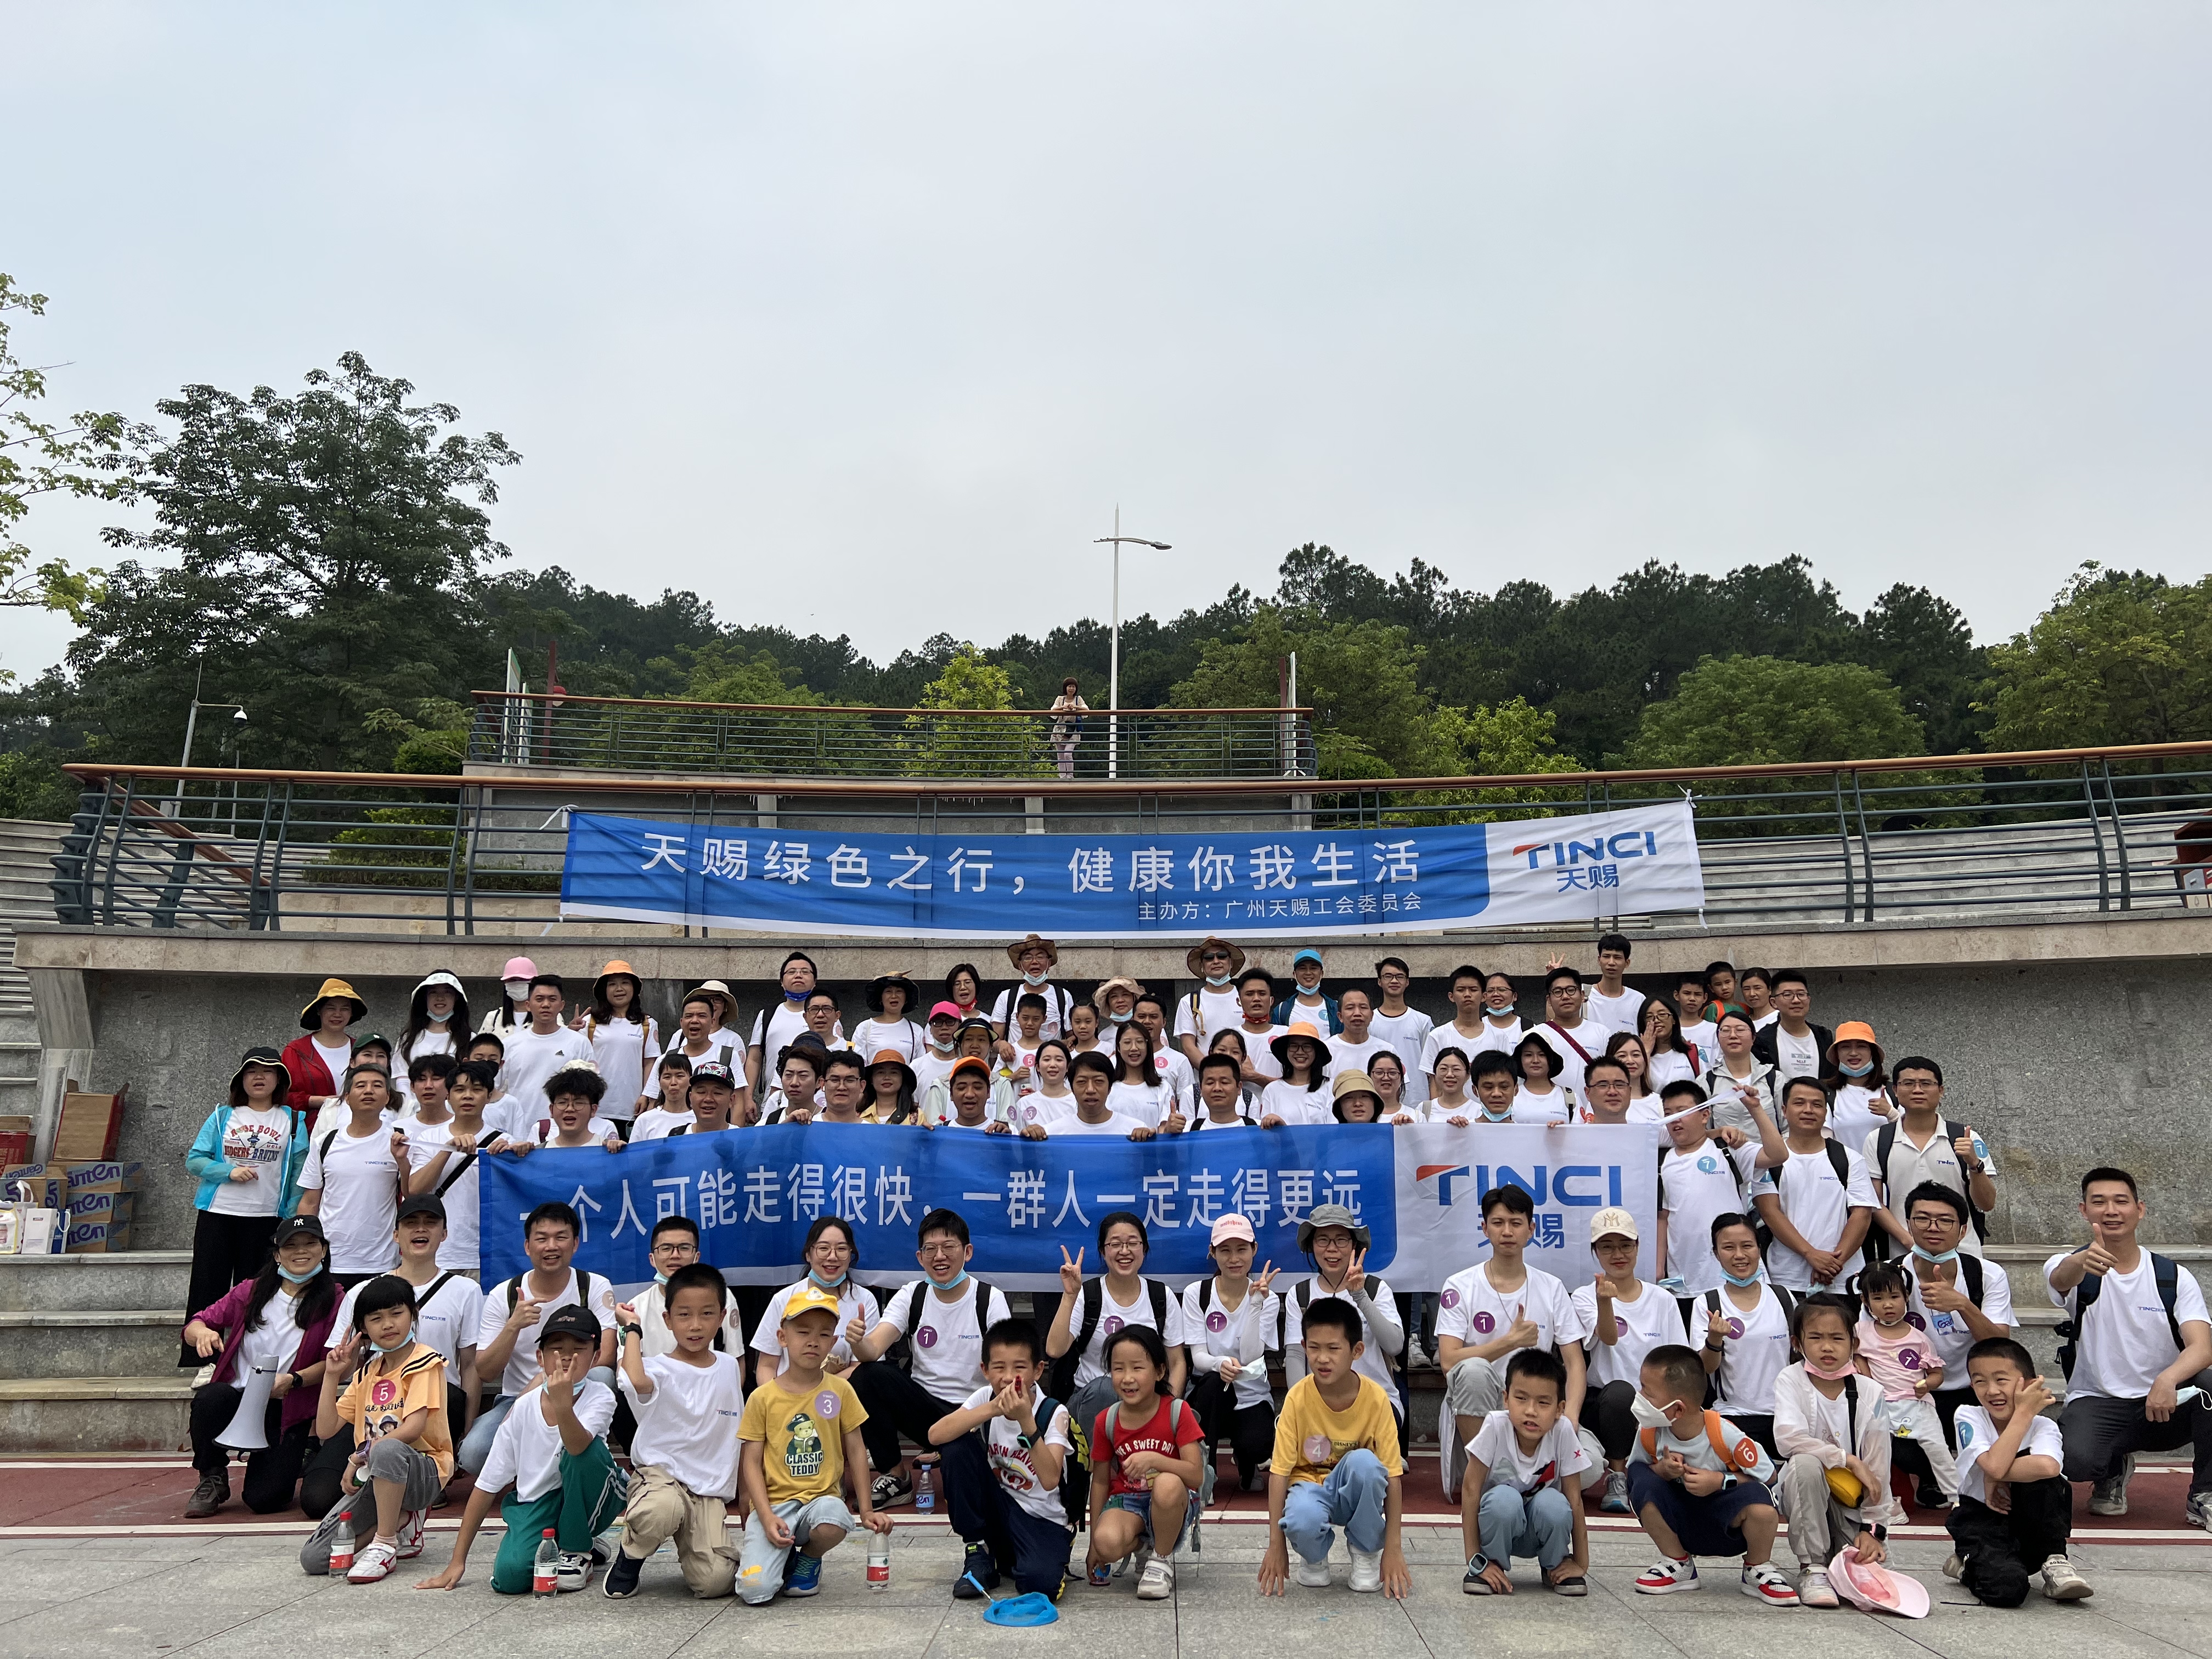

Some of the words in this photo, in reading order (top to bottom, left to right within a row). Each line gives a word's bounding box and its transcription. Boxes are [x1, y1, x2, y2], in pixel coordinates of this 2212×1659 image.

[1513, 831, 1657, 868] TINCI
[1557, 865, 1619, 893] 天赐
[1138, 892, 1421, 921] 主办方：广州天赐工会委员会
[257, 1125, 283, 1142] BOWL
[1976, 1144, 1983, 1155] 7
[1702, 1160, 1711, 1170] 7
[1416, 1165, 1622, 1206] TINCI
[609, 1296, 615, 1307] 2
[1446, 1295, 1452, 1306] 1
[1110, 1322, 1116, 1333] 1
[1213, 1317, 1218, 1329] 1
[1480, 1318, 1486, 1330] 1
[923, 1332, 929, 1345] 1
[379, 1387, 389, 1401] 5
[823, 1398, 833, 1414] 3
[999, 1445, 1009, 1458] IN
[1125, 1443, 1132, 1453] A
[1133, 1438, 1160, 1451] SWEET
[1162, 1440, 1176, 1455] DAY
[1312, 1444, 1322, 1458] 4
[786, 1452, 824, 1465] CLASSIC
[1743, 1447, 1755, 1463] 6
[791, 1463, 819, 1476] TEDDY
